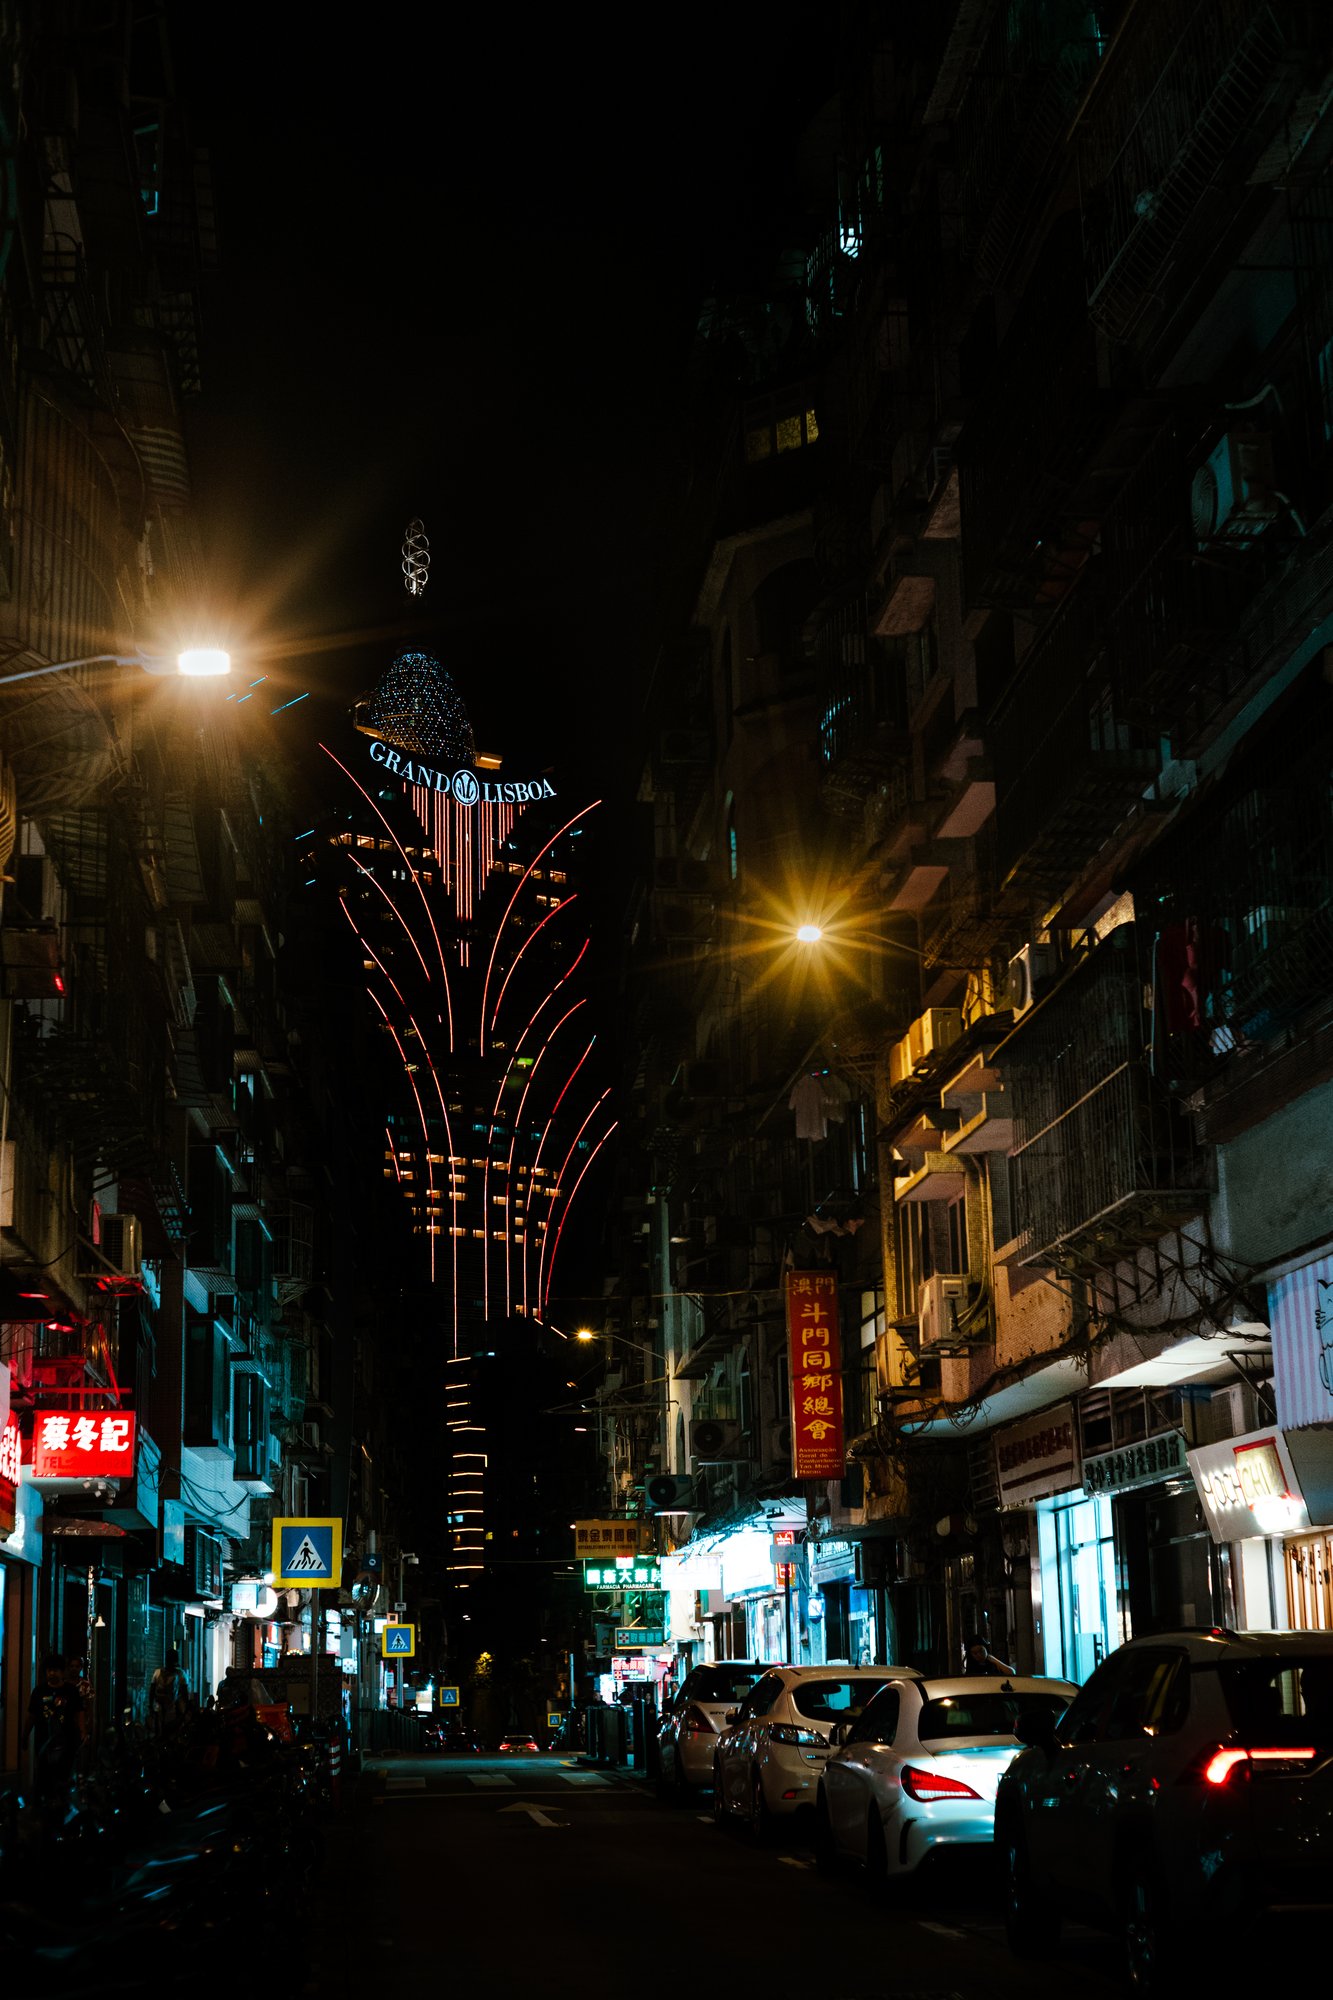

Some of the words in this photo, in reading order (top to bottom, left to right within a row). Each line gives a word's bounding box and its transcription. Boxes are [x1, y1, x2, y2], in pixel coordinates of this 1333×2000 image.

[369, 741, 451, 793] GRAND
[482, 778, 557, 803] LISBOA
[793, 1277, 835, 1296] 澳門
[801, 1302, 837, 1441] 斗門同鄉總會
[42, 1415, 130, 1452] 蔡冬記
